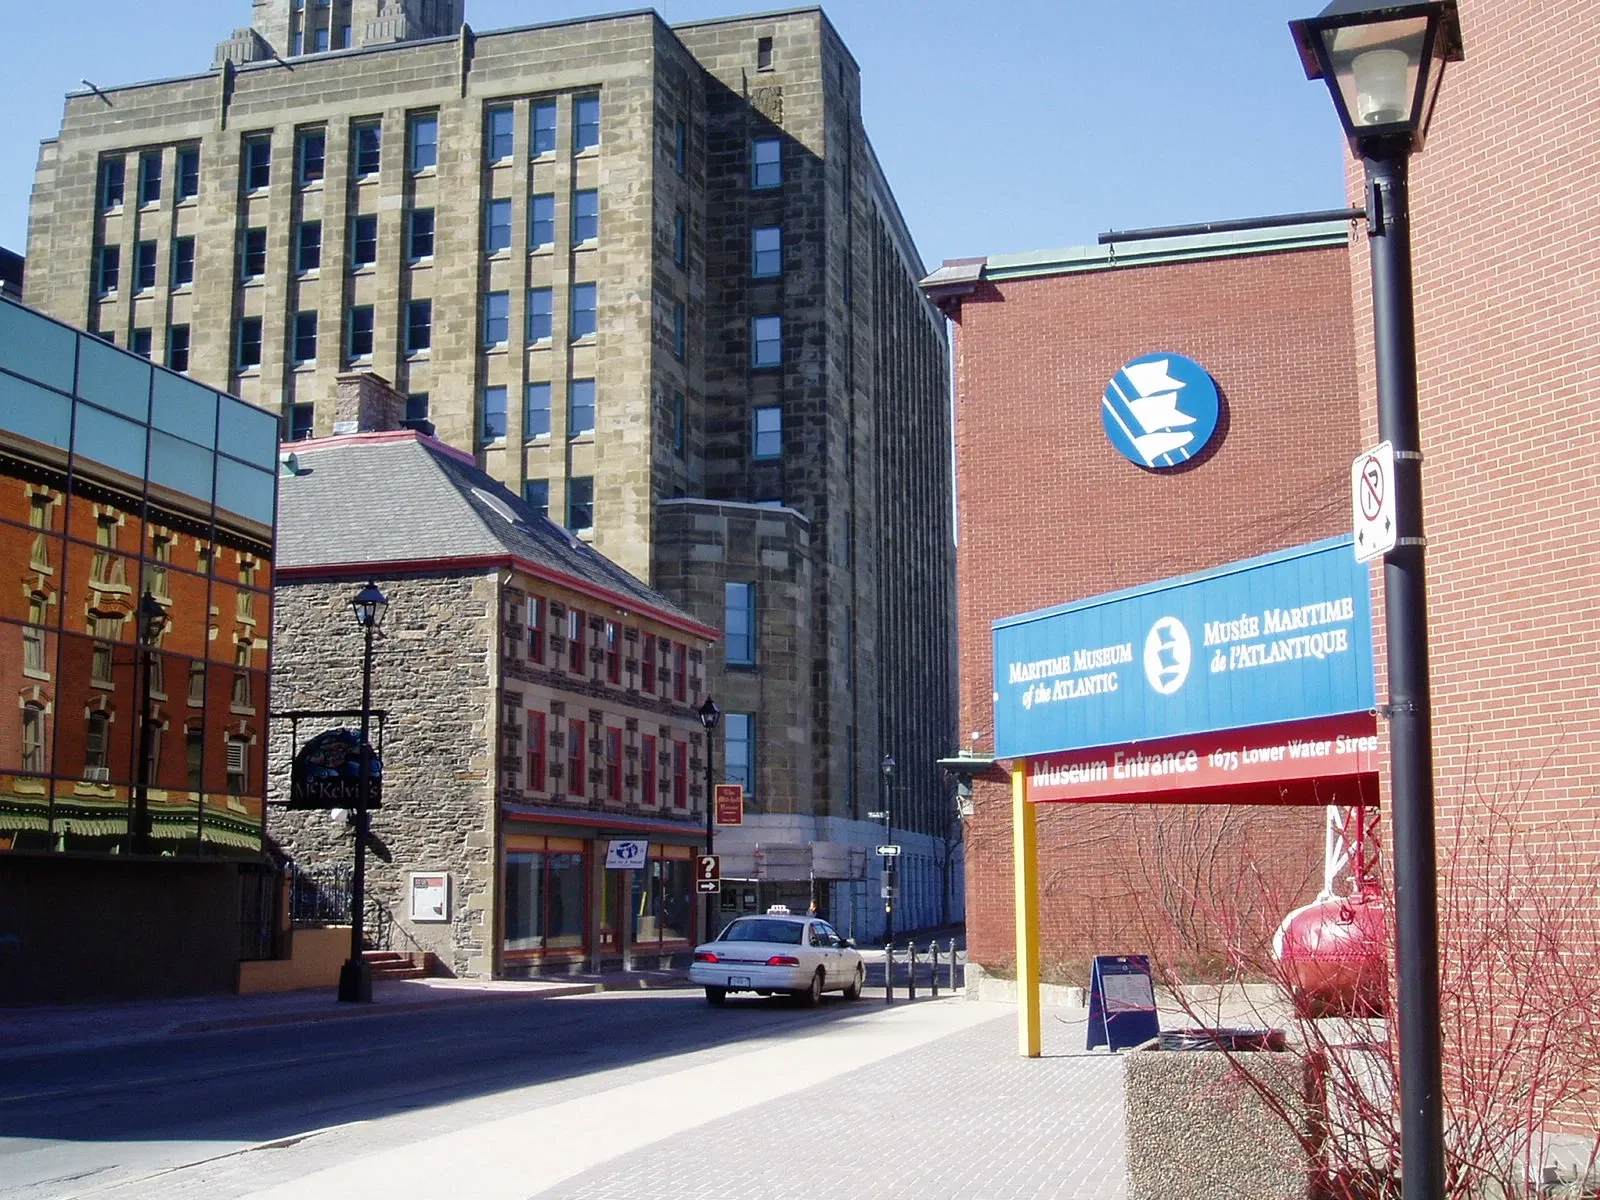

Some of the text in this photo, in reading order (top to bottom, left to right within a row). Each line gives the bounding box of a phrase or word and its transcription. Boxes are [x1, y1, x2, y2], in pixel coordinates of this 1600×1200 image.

[1203, 597, 1354, 646] MUSÉE MARITIME
[1009, 642, 1133, 685] MARITIME MUSEUM
[1210, 628, 1348, 673] de l'ATLANTIQUE
[1022, 671, 1118, 710] of the ATLANTIC
[1033, 734, 1378, 787] Museum Entrance 1675 Lower Water Stree
[295, 780, 378, 798] McKelvi's
